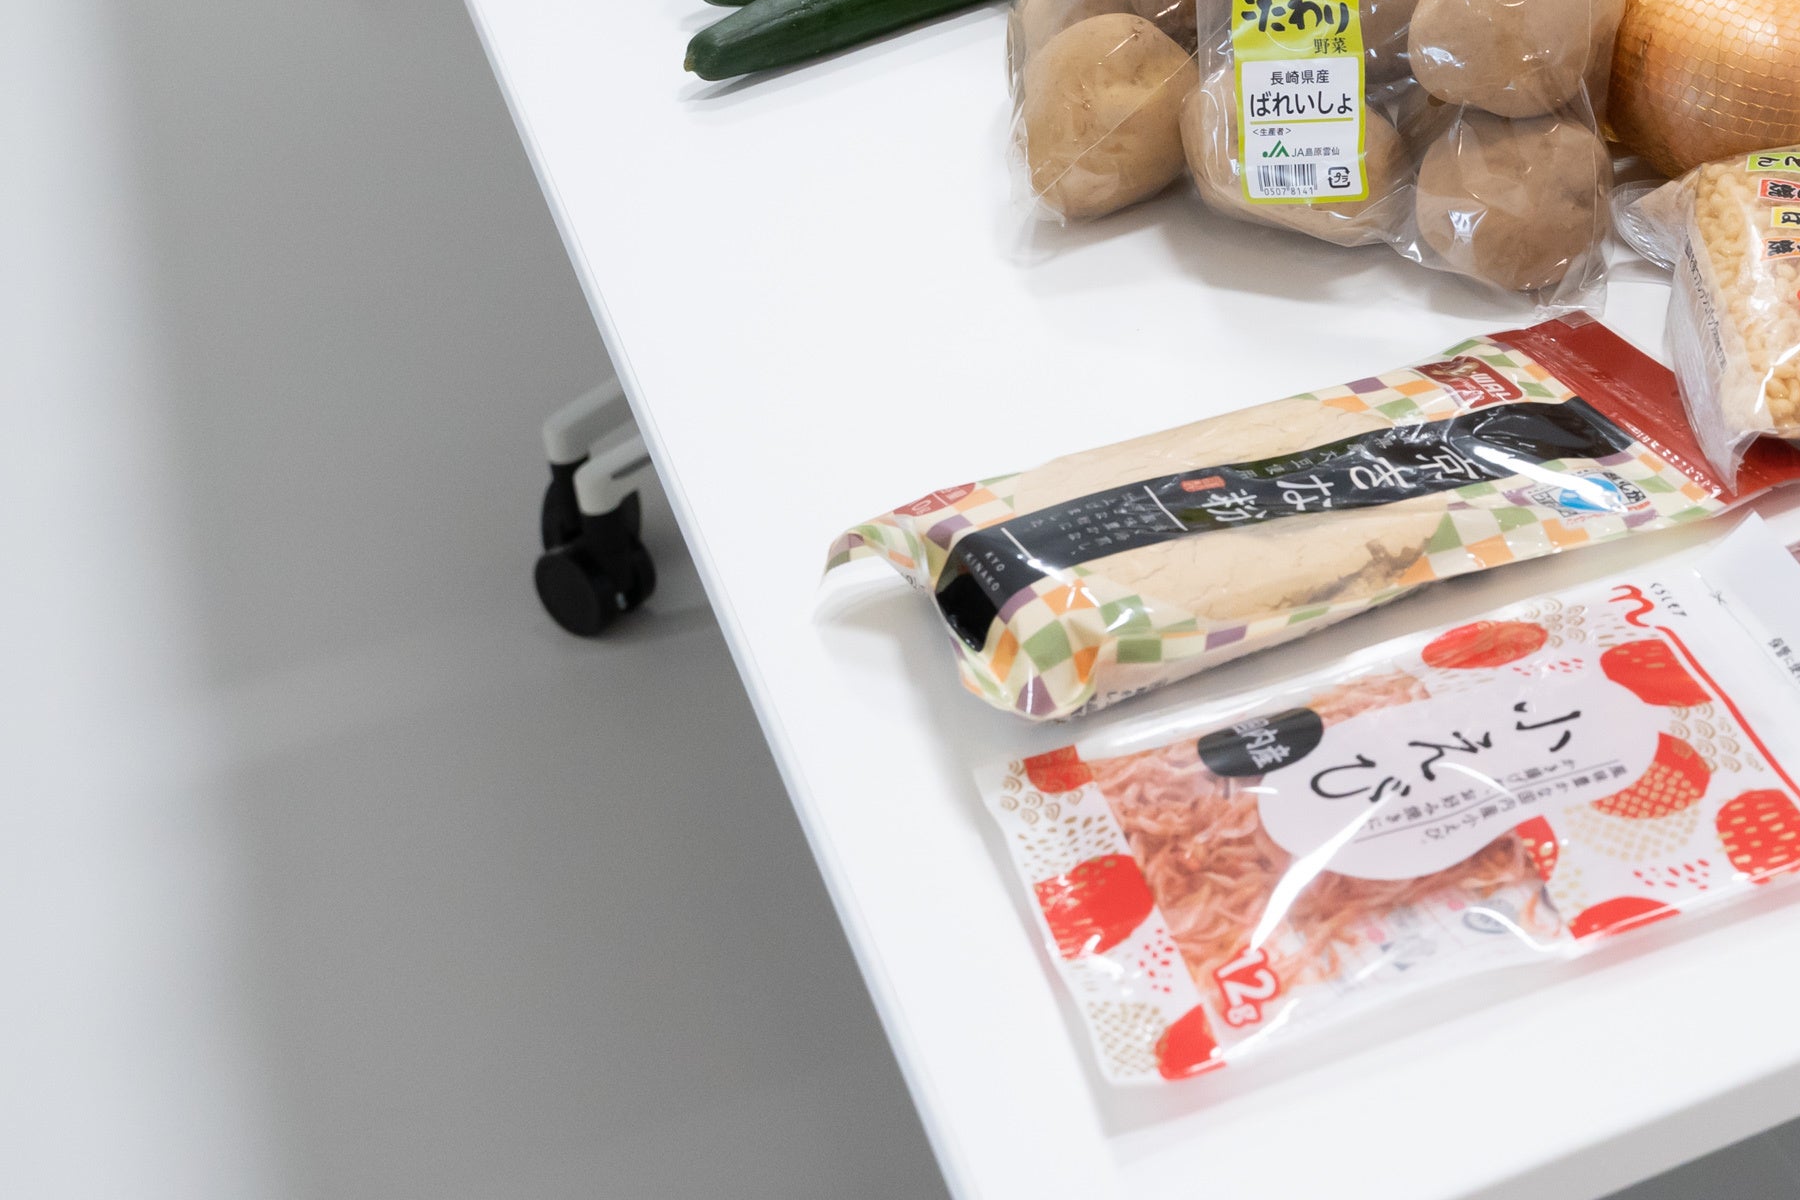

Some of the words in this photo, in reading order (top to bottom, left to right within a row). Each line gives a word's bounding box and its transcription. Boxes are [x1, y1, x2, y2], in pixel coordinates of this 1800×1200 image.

[1313, 37, 1348, 55] 野菜
[1270, 69, 1330, 86] 長崎県産
[1250, 91, 1354, 118] ばれいしょ
[1200, 445, 1486, 524] 京きな粉
[965, 552, 1001, 592] KINAKO
[984, 551, 1006, 572] KYO
[1310, 701, 1582, 803] 小えび
[1215, 949, 1277, 1025] 12g
